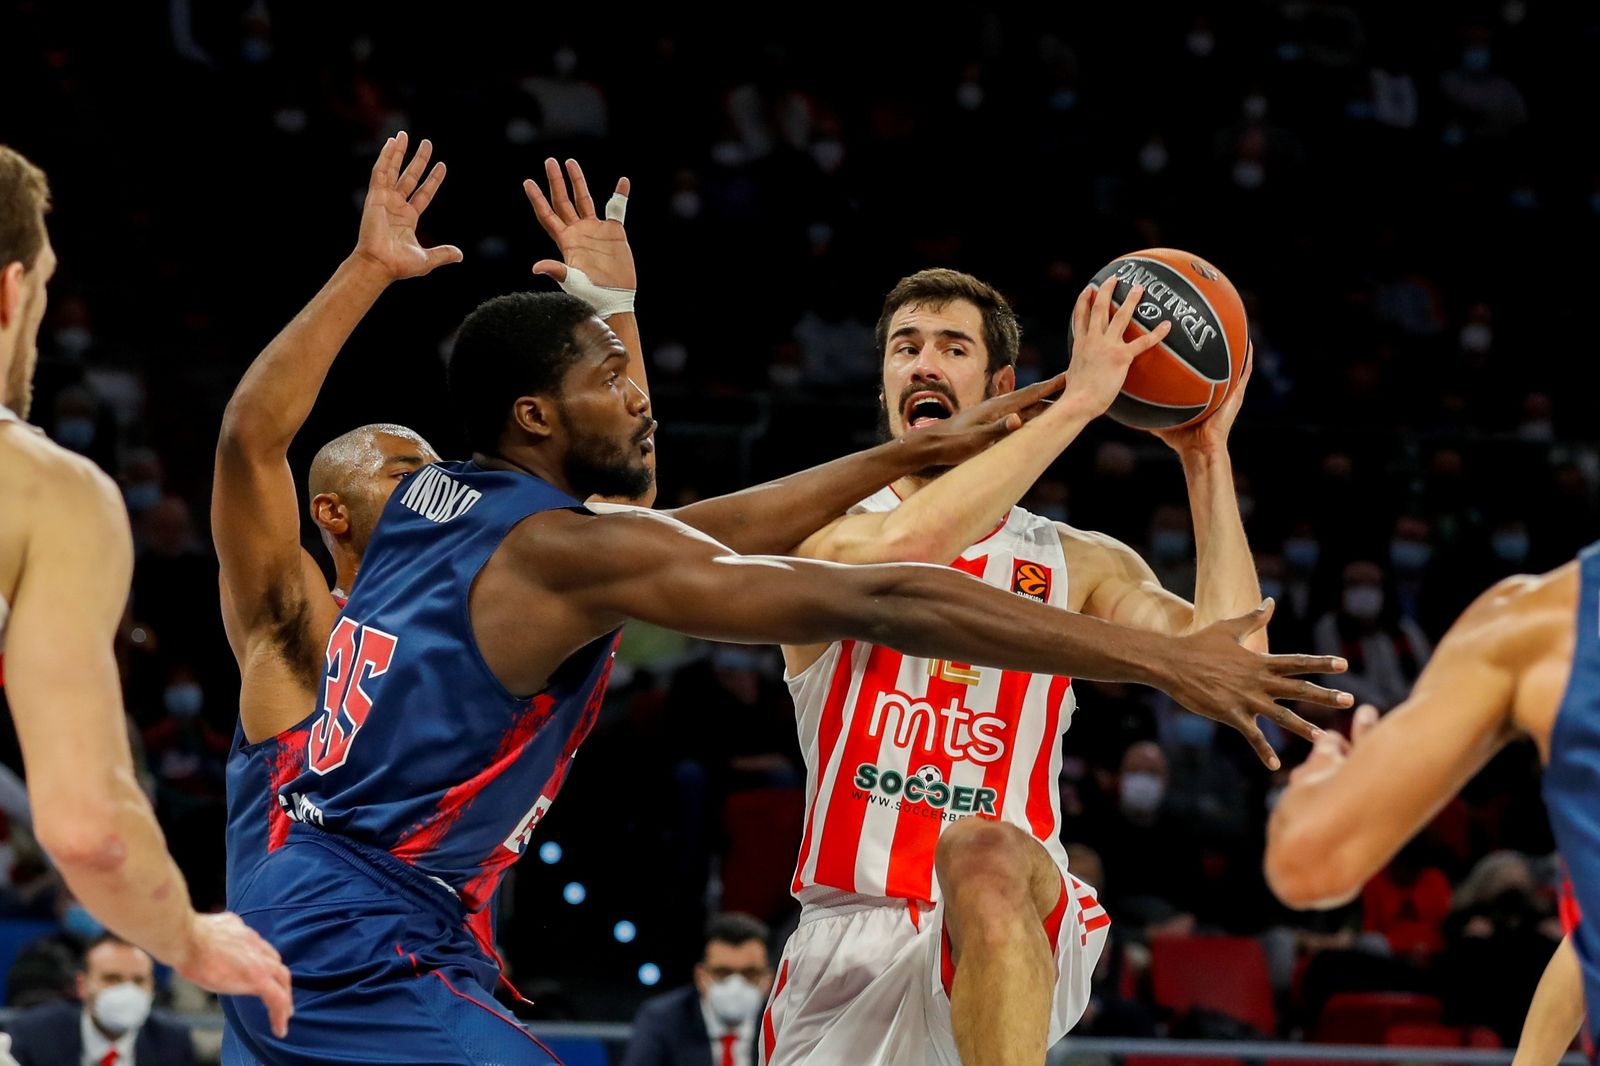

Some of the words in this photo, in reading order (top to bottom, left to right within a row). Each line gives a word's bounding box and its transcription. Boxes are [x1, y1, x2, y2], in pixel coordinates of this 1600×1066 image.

[1117, 262, 1217, 351] SPALDING
[400, 465, 482, 523] NNOKO
[308, 616, 398, 776] 35
[868, 691, 1006, 762] mts
[854, 763, 997, 815] SOCCER
